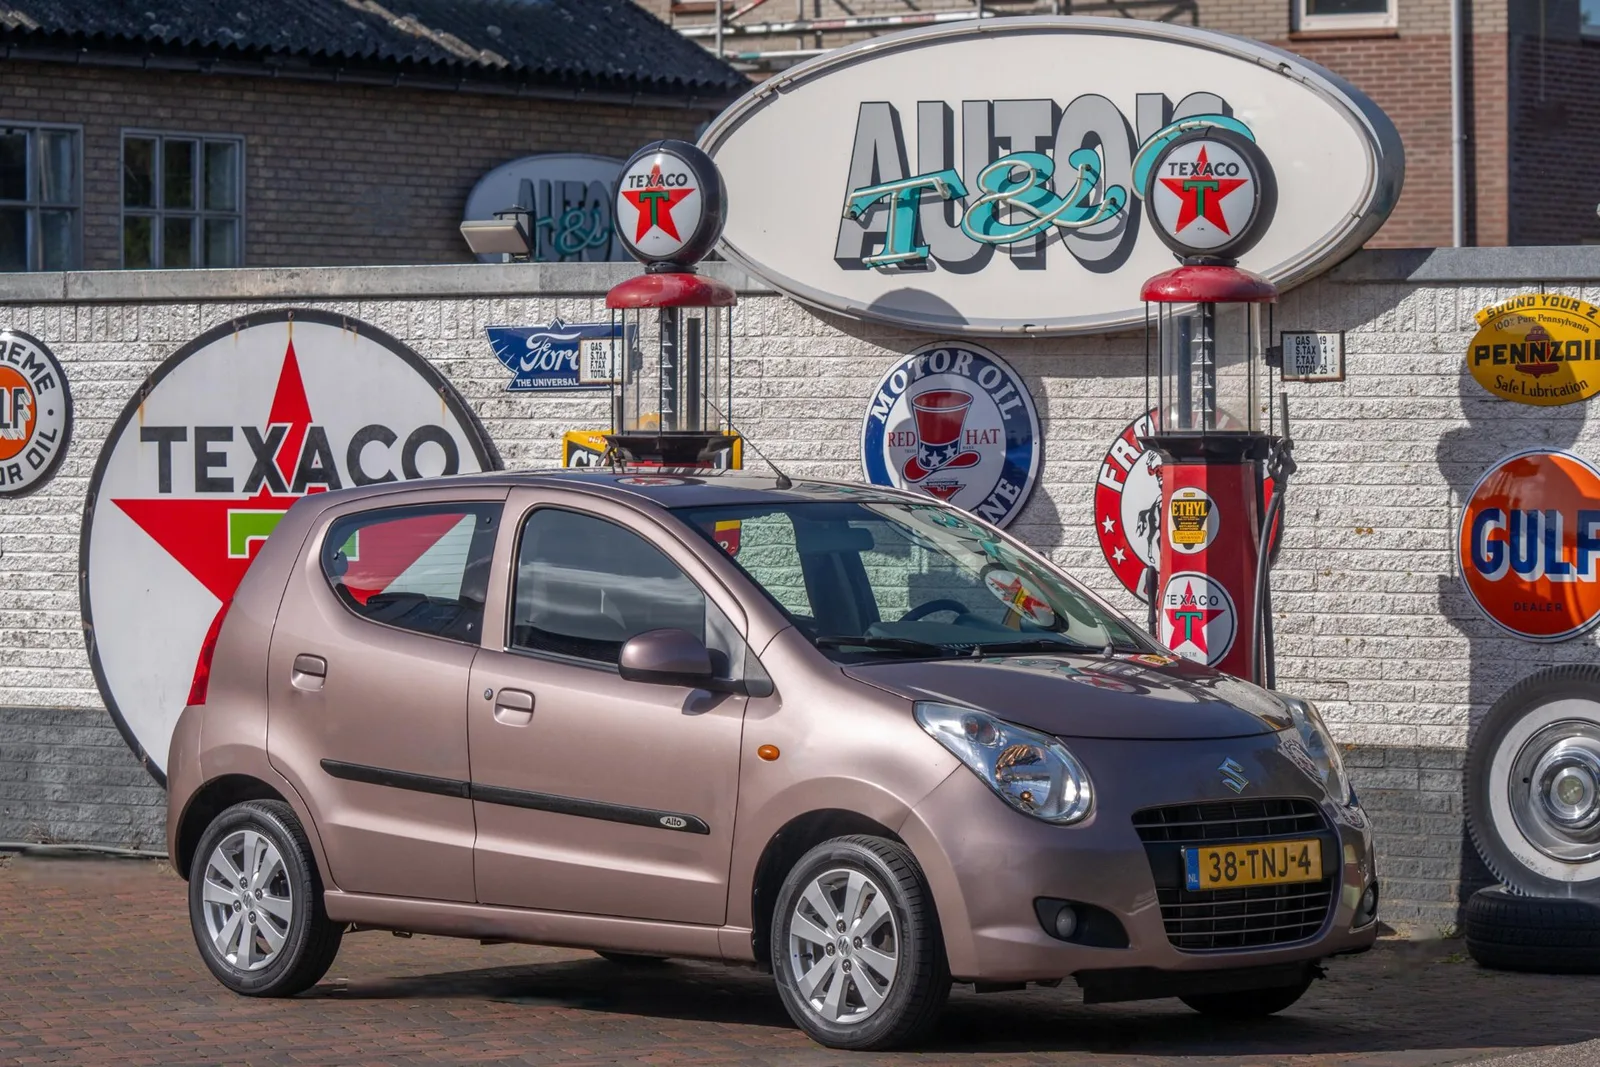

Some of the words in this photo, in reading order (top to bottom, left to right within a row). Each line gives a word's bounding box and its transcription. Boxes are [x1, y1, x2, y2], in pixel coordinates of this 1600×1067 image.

[1168, 162, 1239, 176] TEXACO
[629, 173, 687, 188] TEXACO
[834, 92, 1234, 273] AUTO'
[1541, 295, 1580, 312] YOUR
[1518, 315, 1537, 325] Pure
[1538, 314, 1590, 334] Pennsylvania
[590, 342, 602, 351] GAS
[1295, 336, 1310, 345] GAS
[590, 351, 607, 360] S.TAX
[1295, 346, 1316, 355] S.TAX
[1474, 339, 1600, 367] PENNZOI
[590, 361, 606, 369] F.TAX
[1295, 355, 1315, 365] F.TAX
[590, 370, 607, 378] TOTAL
[1296, 365, 1317, 375] TOTAL
[516, 379, 532, 387] THE
[532, 378, 579, 387] UNIVERSAL
[871, 349, 974, 425] MOTOR
[977, 366, 1023, 420] OIL
[1494, 375, 1519, 394] Safe
[1521, 379, 1589, 398] Lubrication
[887, 431, 916, 447] RED
[965, 429, 1000, 445] HAT
[25, 428, 58, 470] OIL
[140, 423, 460, 494] TEXACO
[1172, 501, 1207, 517] ETHYL
[1471, 508, 1600, 580] GULF
[1513, 602, 1563, 612] DEALER
[665, 817, 682, 826] Alto
[1209, 844, 1311, 882] 38-TNJ-4
[1188, 874, 1198, 883] NL
